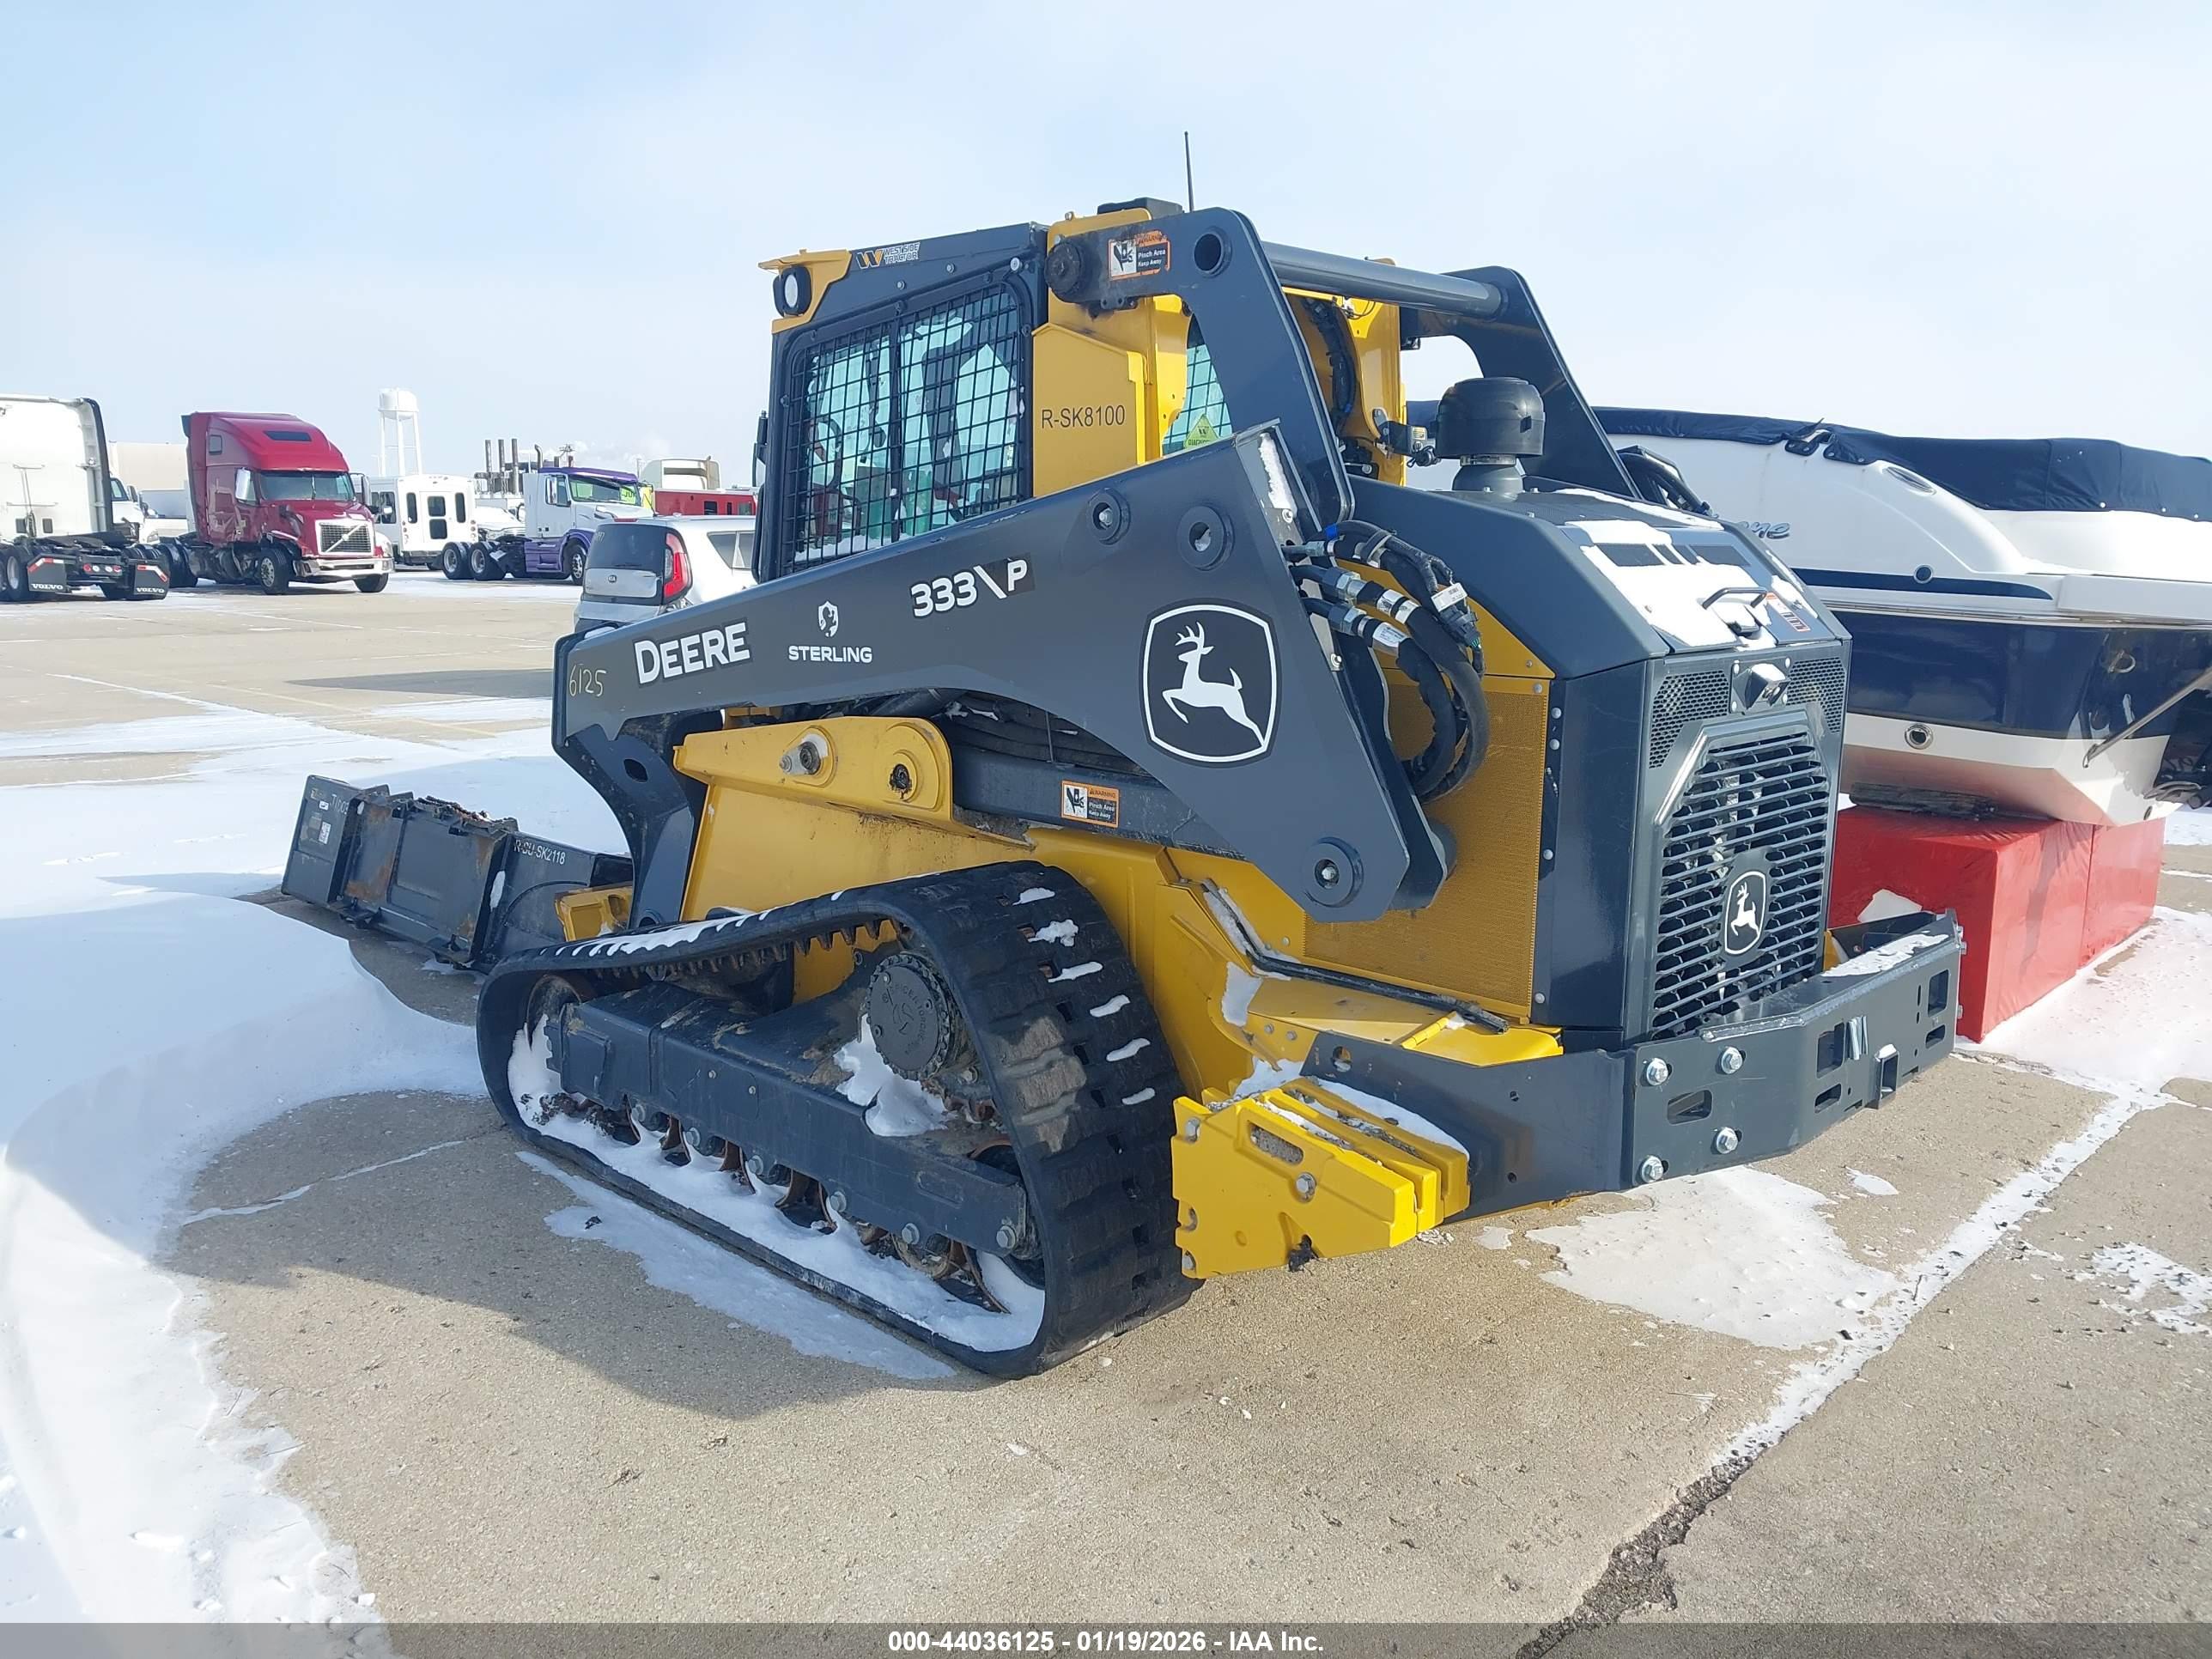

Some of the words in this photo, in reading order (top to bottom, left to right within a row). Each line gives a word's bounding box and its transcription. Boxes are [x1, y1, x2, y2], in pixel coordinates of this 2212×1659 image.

[883, 246, 902, 256] WEST
[903, 242, 921, 252] SIDE
[1138, 250, 1153, 259] Pinch
[884, 252, 919, 264] TRACTOR
[1042, 404, 1126, 428] R-SK8100
[635, 623, 750, 684] DEERE
[788, 646, 872, 663] STERLING
[569, 664, 607, 697] 6125
